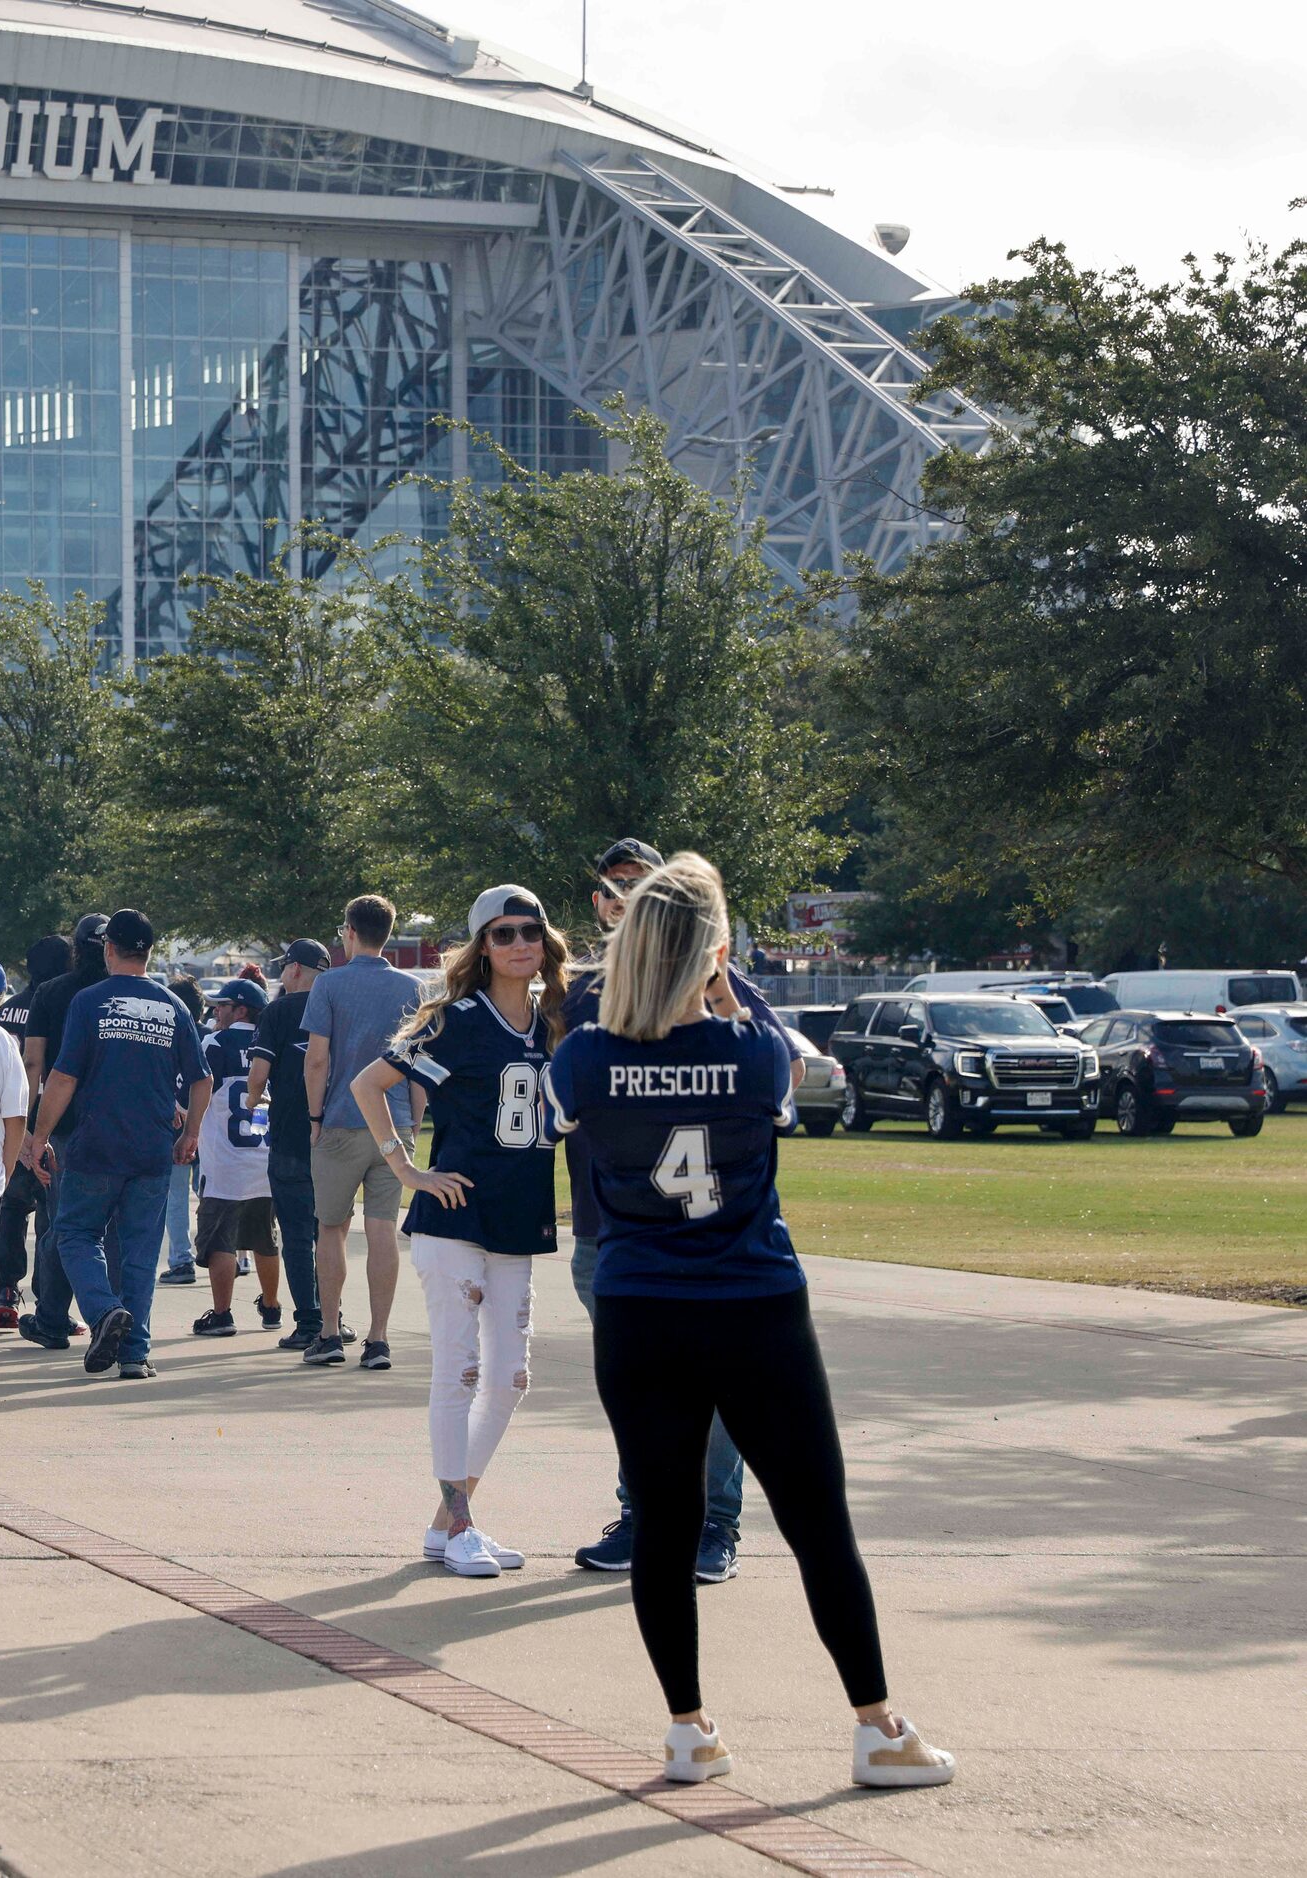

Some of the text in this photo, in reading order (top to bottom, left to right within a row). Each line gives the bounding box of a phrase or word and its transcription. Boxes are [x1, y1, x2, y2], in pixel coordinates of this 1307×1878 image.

[117, 997, 176, 1026] STAR
[98, 1018, 139, 1030] SPORTS
[141, 1022, 174, 1037] TOURS
[98, 1031, 173, 1048] COWBOYSTRAVEL.COM
[609, 1063, 738, 1097] PRESCOTT
[494, 1062, 556, 1149] 8
[649, 1124, 723, 1220] 4
